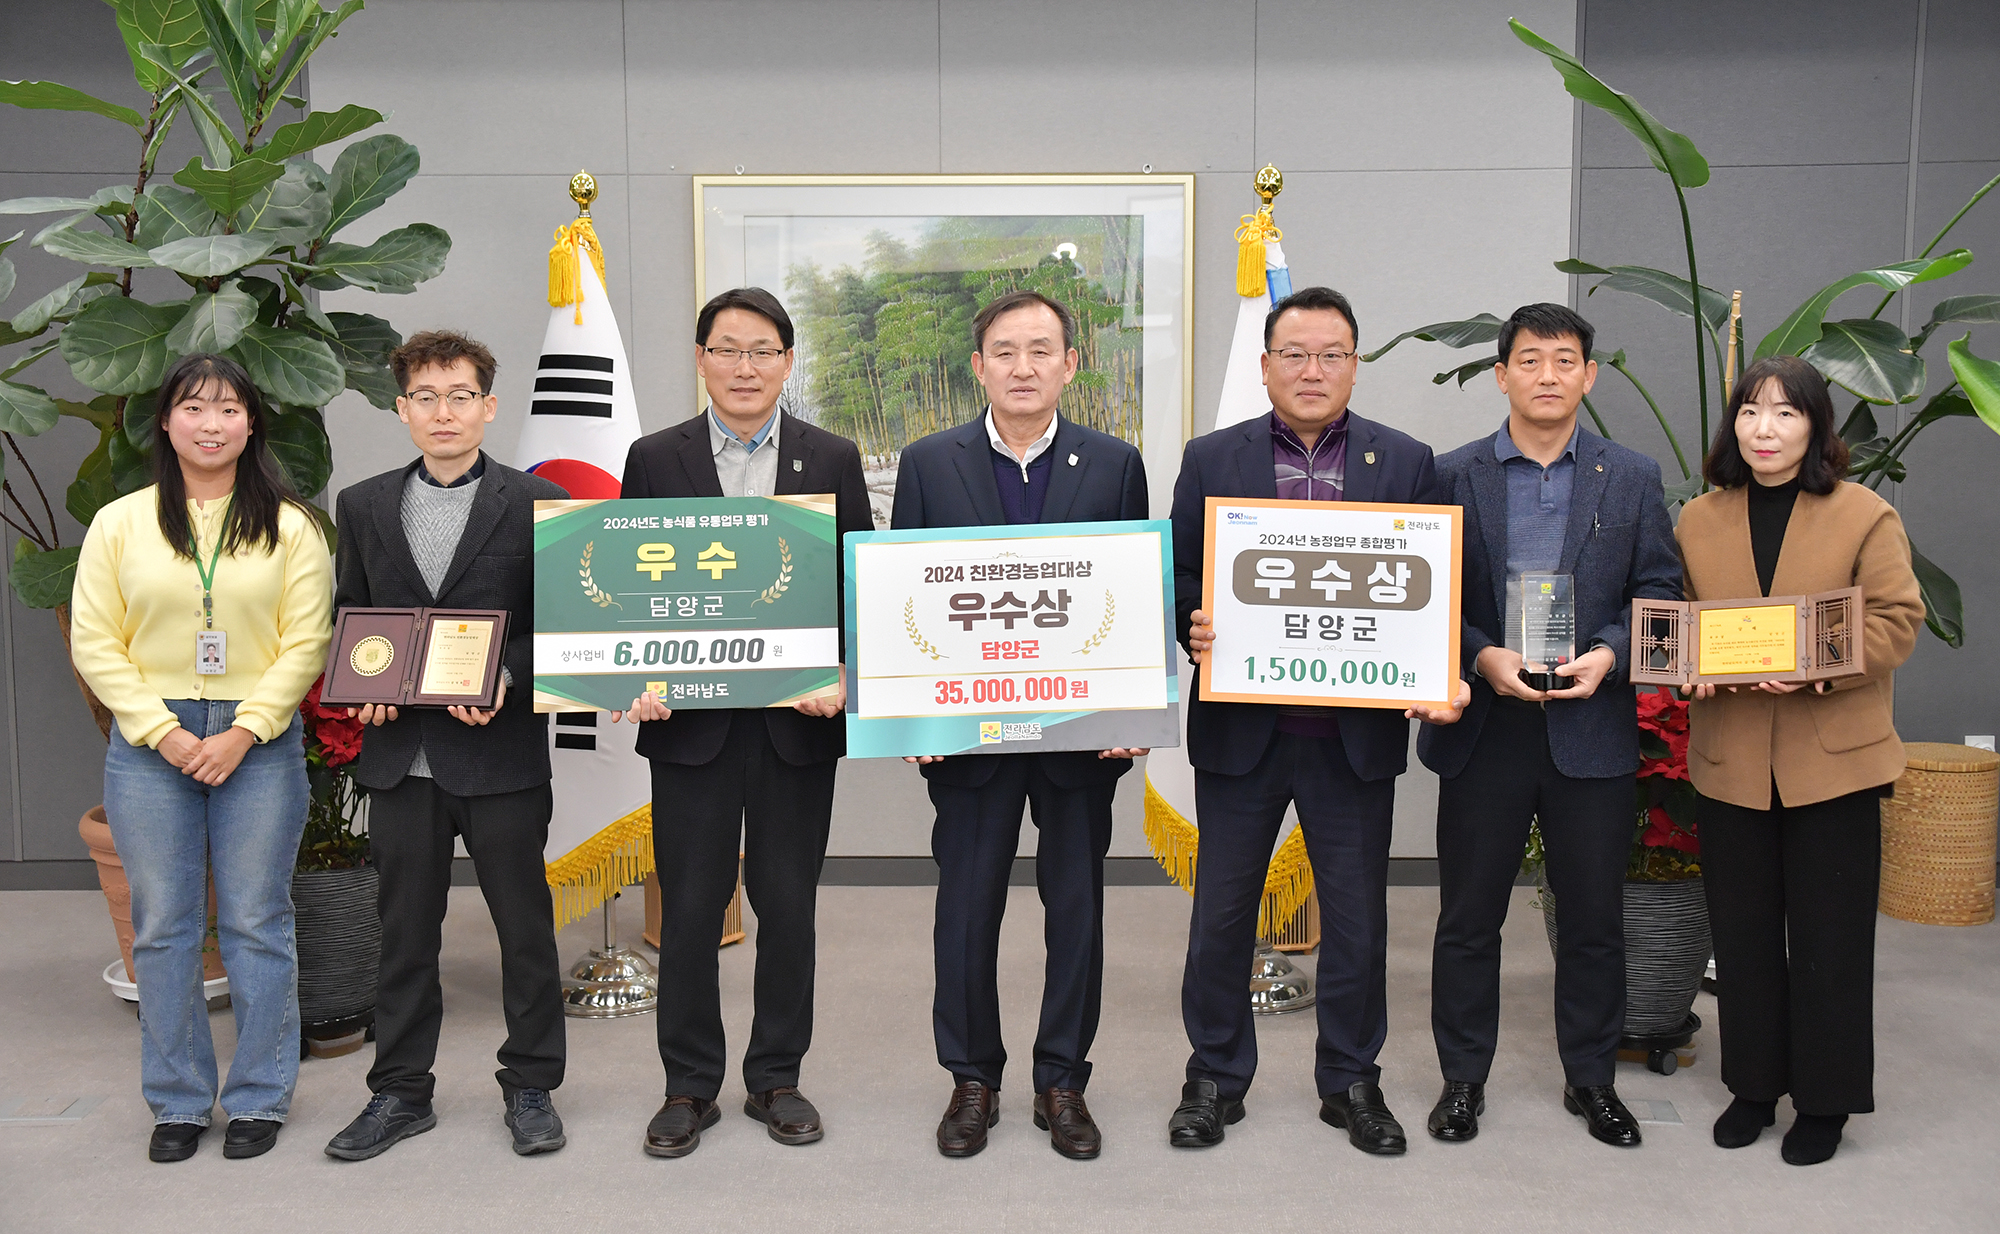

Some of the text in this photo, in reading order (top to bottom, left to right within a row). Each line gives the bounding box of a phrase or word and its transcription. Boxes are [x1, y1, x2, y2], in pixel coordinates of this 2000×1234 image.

[603, 514, 769, 530] 2024년도 농식품 유통업무 평가
[1407, 521, 1441, 531] 전라남도
[1259, 534, 1408, 550] 2024년 농정업무 종합평가
[924, 561, 1093, 583] 2024 친환경농업대상
[650, 596, 724, 618] 담양군
[948, 588, 1072, 632] 우수상
[561, 638, 784, 667] 상사업비 6,000,000 원
[981, 640, 1040, 661] 담양군
[671, 683, 730, 700] 전라남도
[1004, 723, 1042, 735] 전라남도
